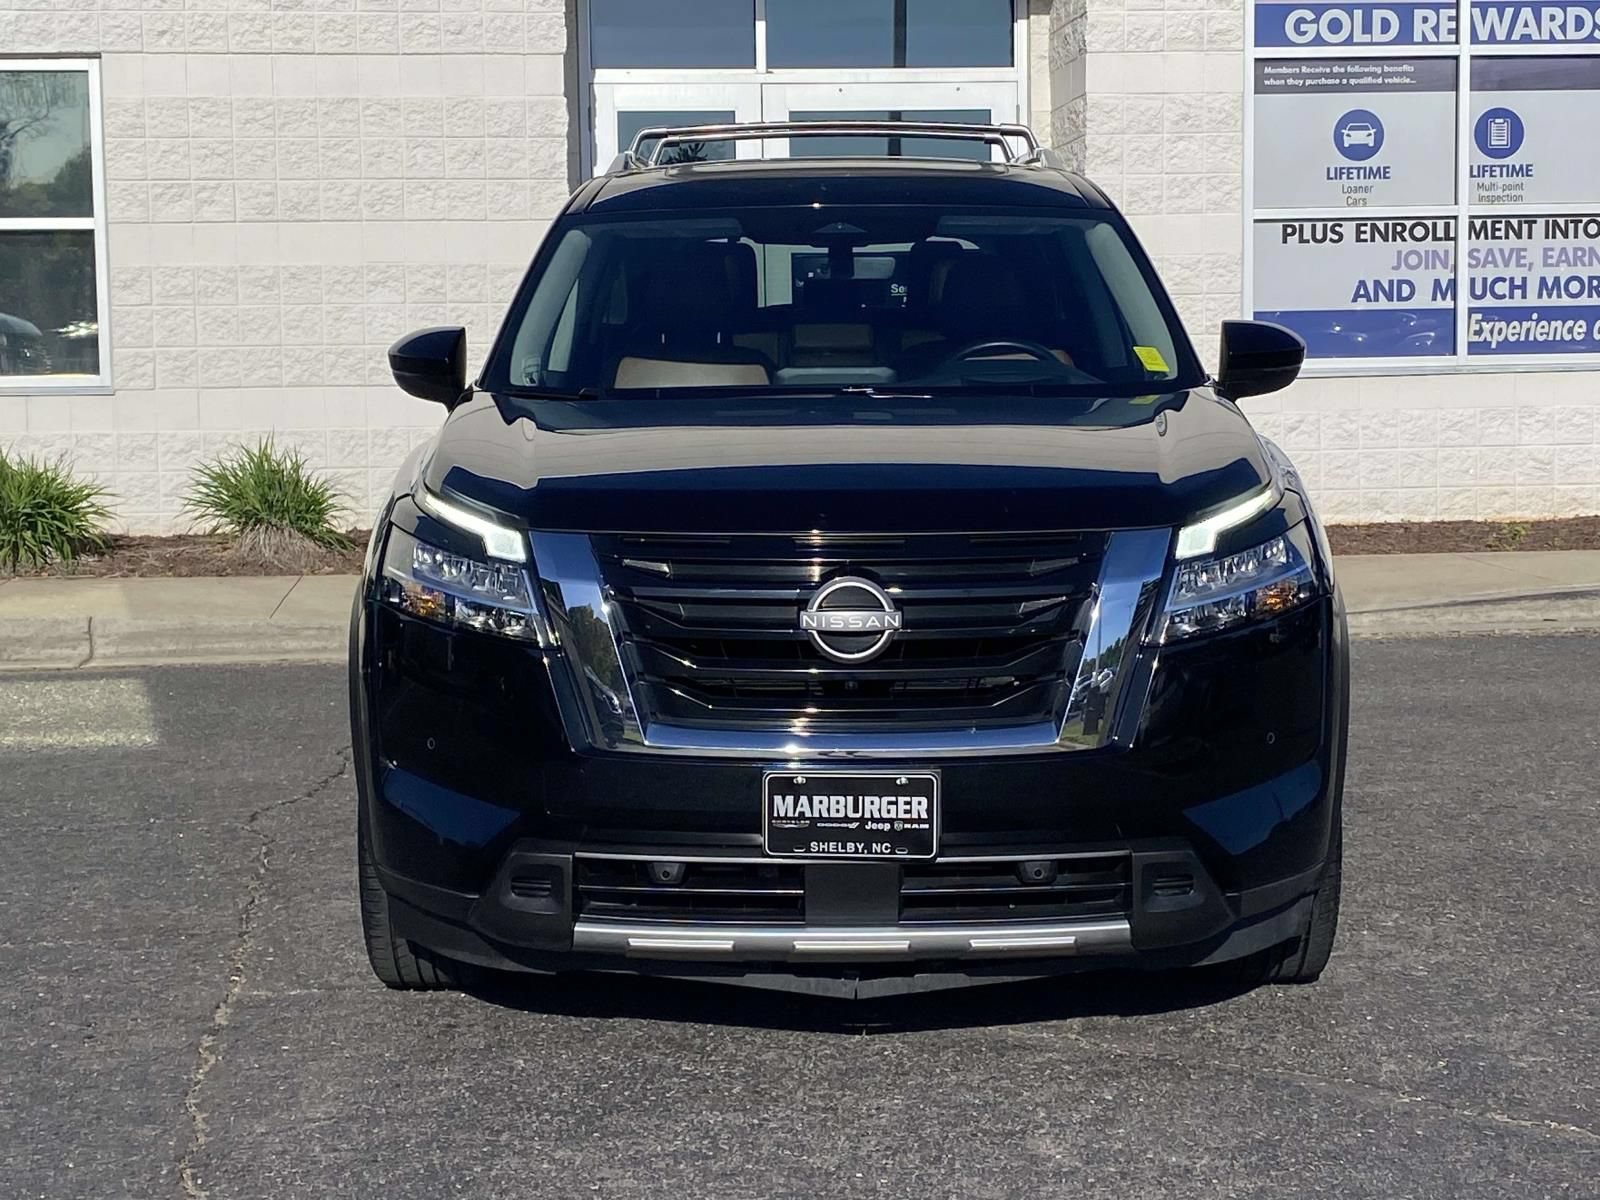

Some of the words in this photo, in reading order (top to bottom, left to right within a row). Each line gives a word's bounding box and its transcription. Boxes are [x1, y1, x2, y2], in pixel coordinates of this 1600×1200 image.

[1284, 8, 1400, 44] GOLD
[1332, 65, 1345, 73] the
[1347, 64, 1382, 74] following
[1383, 64, 1415, 73] benefits
[1286, 77, 1304, 87] they
[1305, 77, 1340, 88] purchase
[1348, 76, 1383, 86] qualified
[1326, 166, 1392, 181] LIFETIME
[1469, 164, 1534, 179] LIFETIME
[1341, 183, 1374, 195] Loaner
[1476, 182, 1525, 193] Multi-point
[1346, 196, 1368, 207] Cars
[1477, 193, 1524, 204] Inspection
[1281, 223, 1344, 245] PLUS
[1544, 218, 1600, 240] INTO
[1468, 247, 1534, 272] SAVE,
[1542, 246, 1600, 268] EARN
[1351, 278, 1416, 303] AND
[1468, 312, 1586, 348] Experience
[802, 615, 899, 628] NISSAN
[773, 795, 928, 819] MARBURGER
[865, 821, 890, 831] Jeep
[810, 842, 867, 854] SHELBY,
[871, 842, 892, 854] NC
